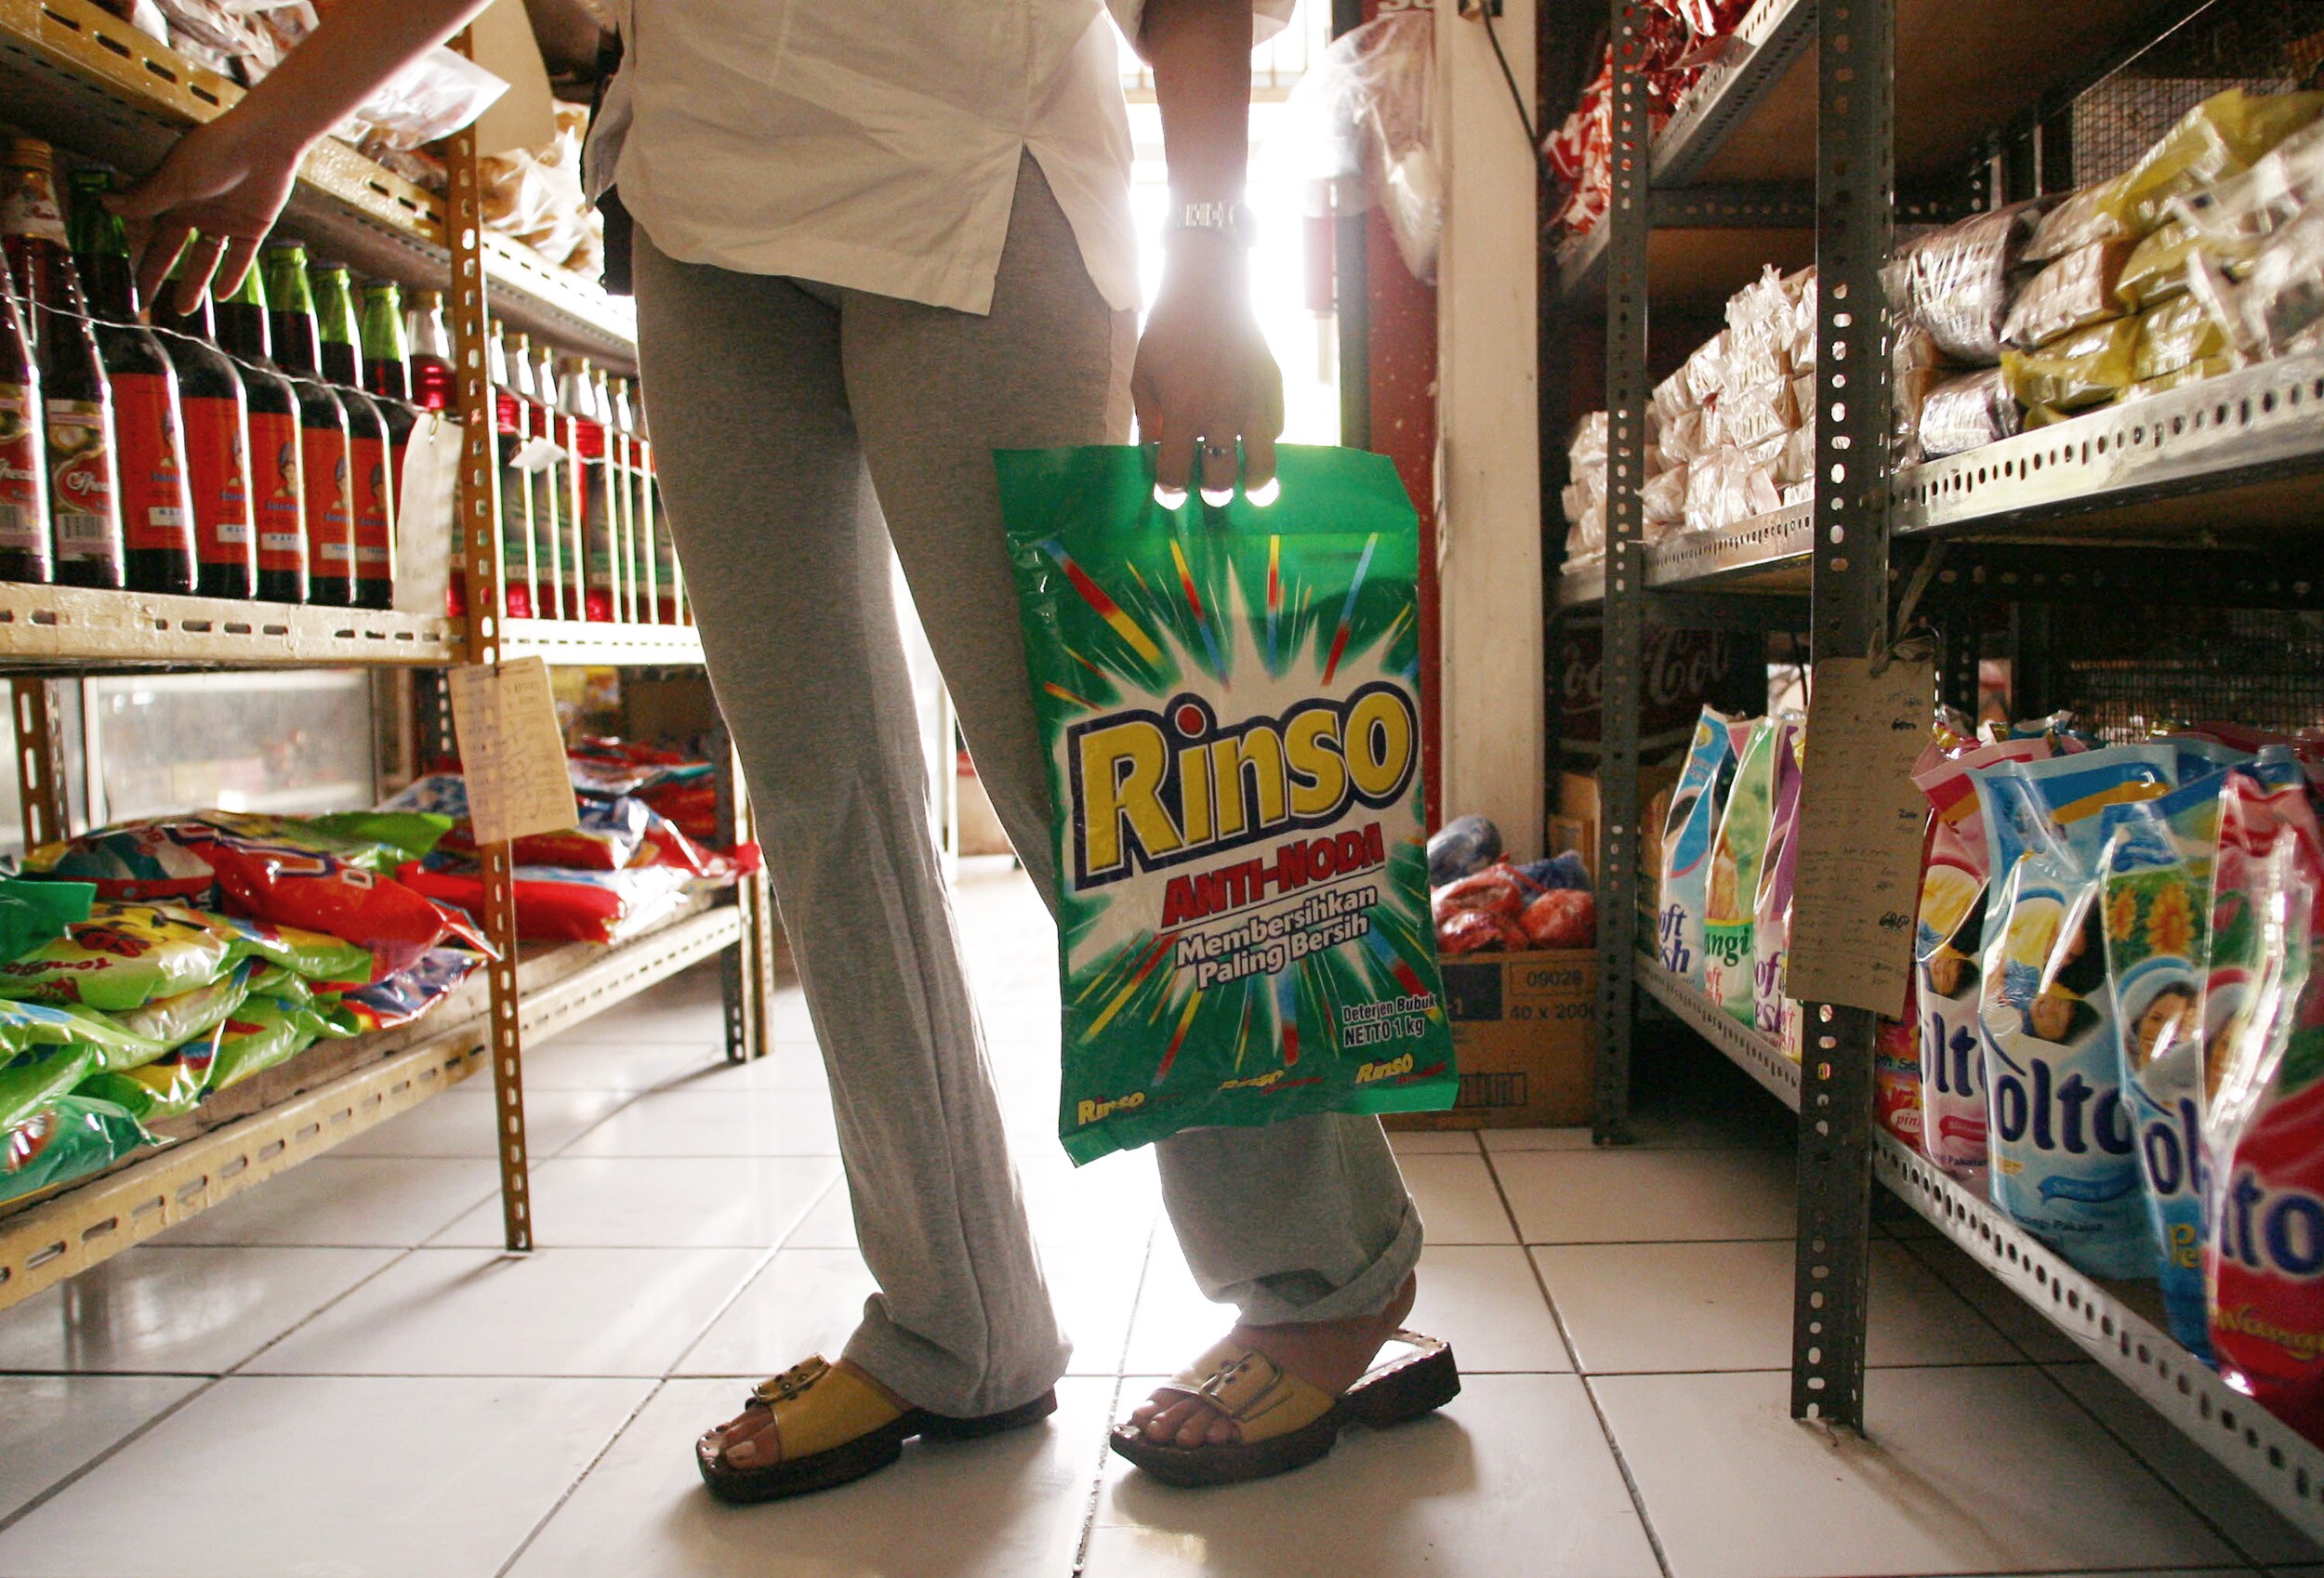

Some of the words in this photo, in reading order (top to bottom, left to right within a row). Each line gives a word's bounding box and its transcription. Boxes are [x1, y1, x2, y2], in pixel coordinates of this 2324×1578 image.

[1073, 687, 1418, 885] Rinso
[1161, 822, 1386, 928] ANTI-NODA
[1176, 886, 1378, 968] Membersihkan
[1197, 943, 1286, 990] Paling
[1289, 914, 1369, 961] Bersih
[1342, 1002, 1394, 1023] Deterjen
[1395, 993, 1436, 1013] Bubuk
[1344, 1019, 1392, 1047] NETTO
[1393, 1018, 1403, 1039] 1
[1405, 1016, 1425, 1038] kg
[1354, 1052, 1414, 1084] Rinso
